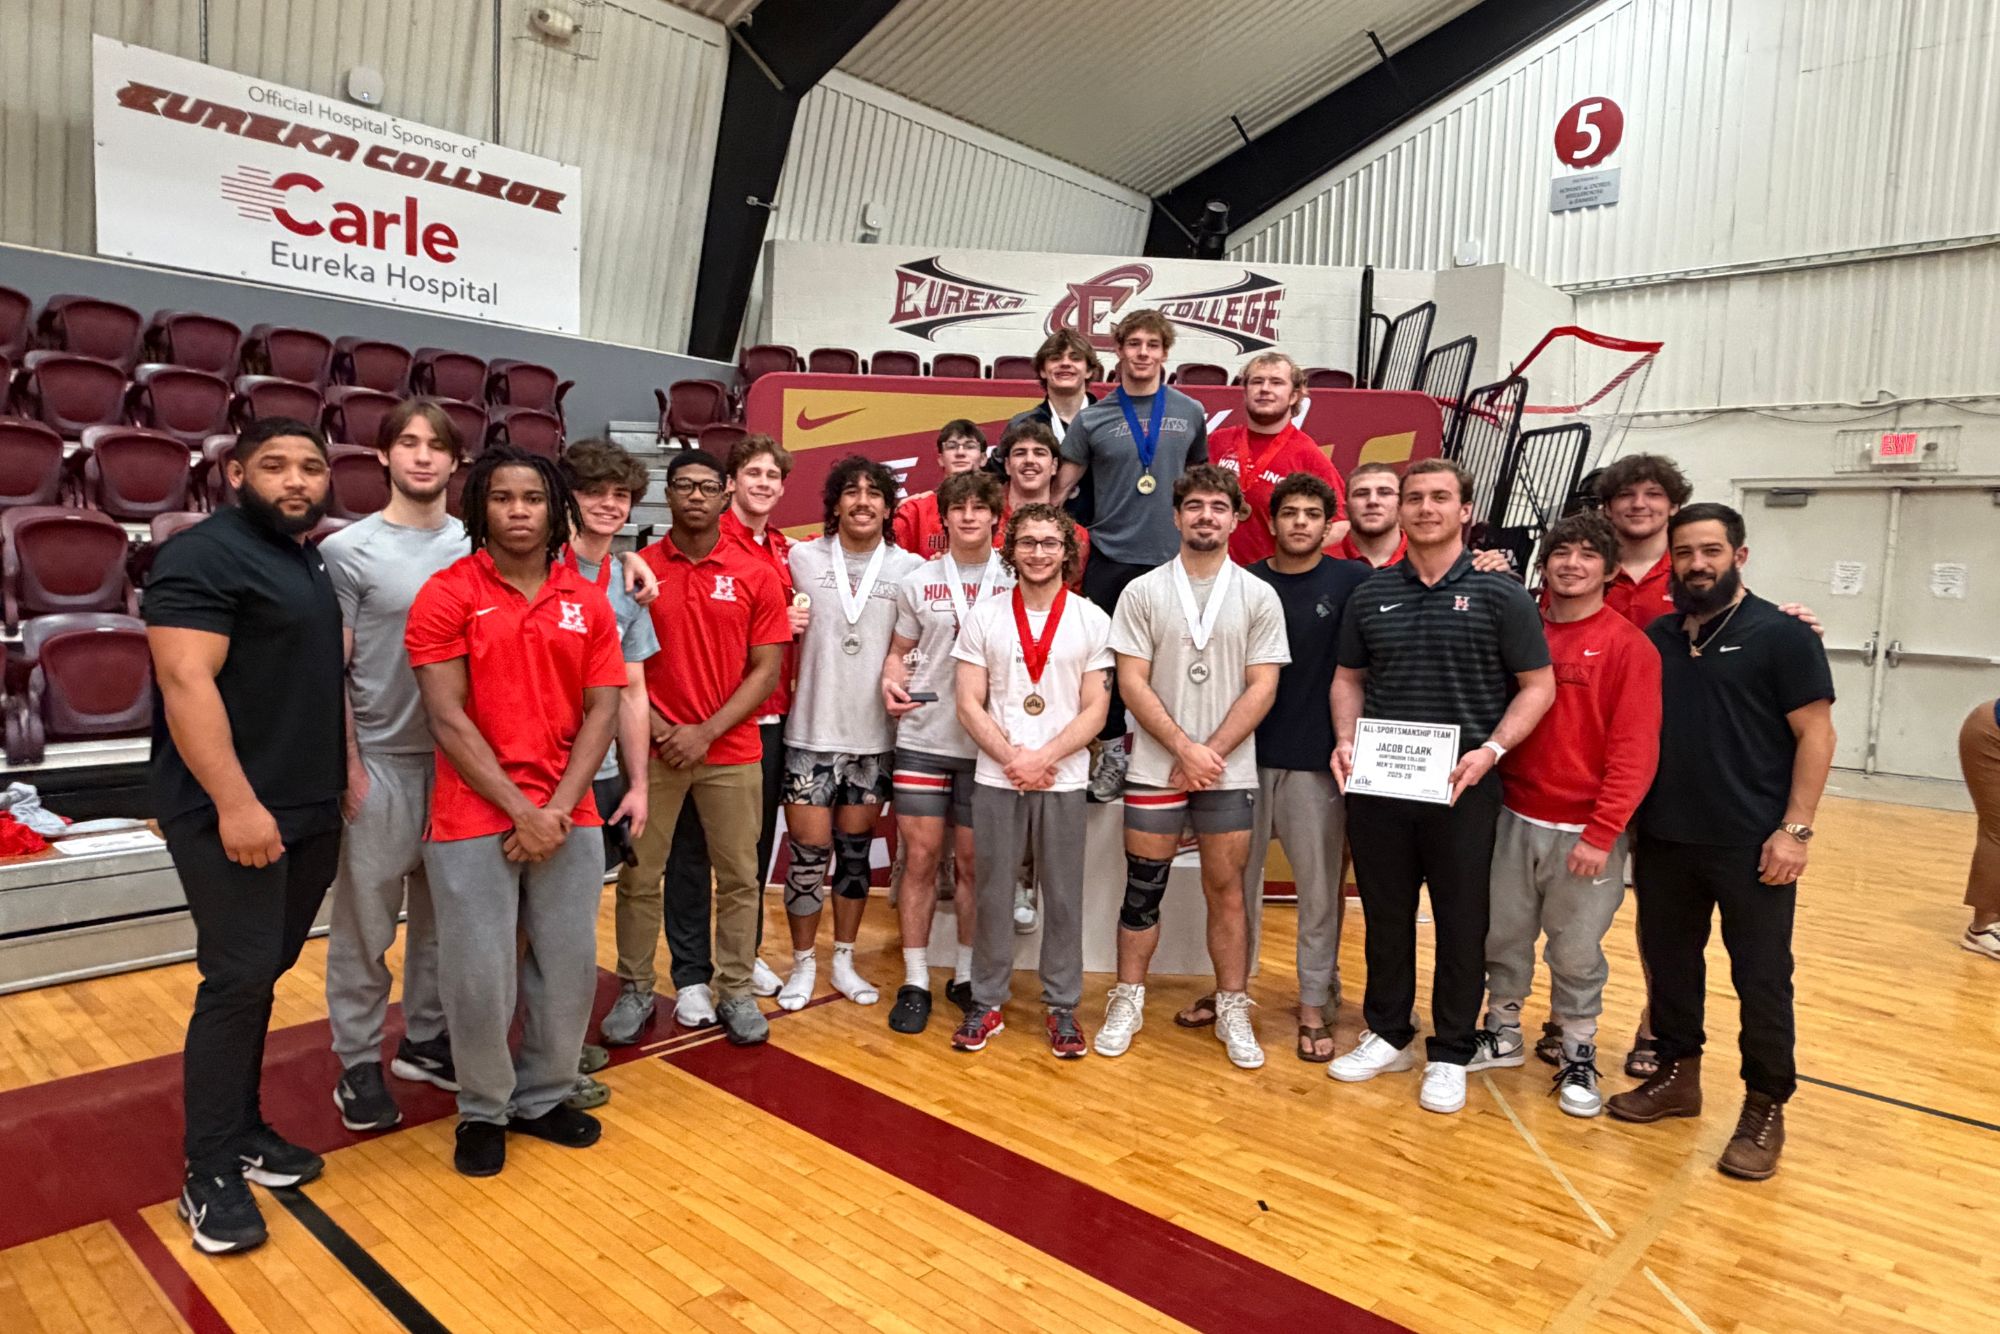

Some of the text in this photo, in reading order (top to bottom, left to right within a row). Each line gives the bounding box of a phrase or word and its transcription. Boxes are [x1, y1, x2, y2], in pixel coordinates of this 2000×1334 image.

[116, 80, 568, 215] EUREKA COLLEGE
[248, 86, 479, 159] Official Hospital Sponsor of
[1572, 102, 1603, 160] 5
[271, 172, 459, 264] Carle
[271, 240, 498, 306] Eureka Hospital
[888, 268, 1287, 342] EUREKA COLLEGE
[1376, 743, 1432, 756] JACOB CLARK
[1433, 731, 1451, 739] TEAM
